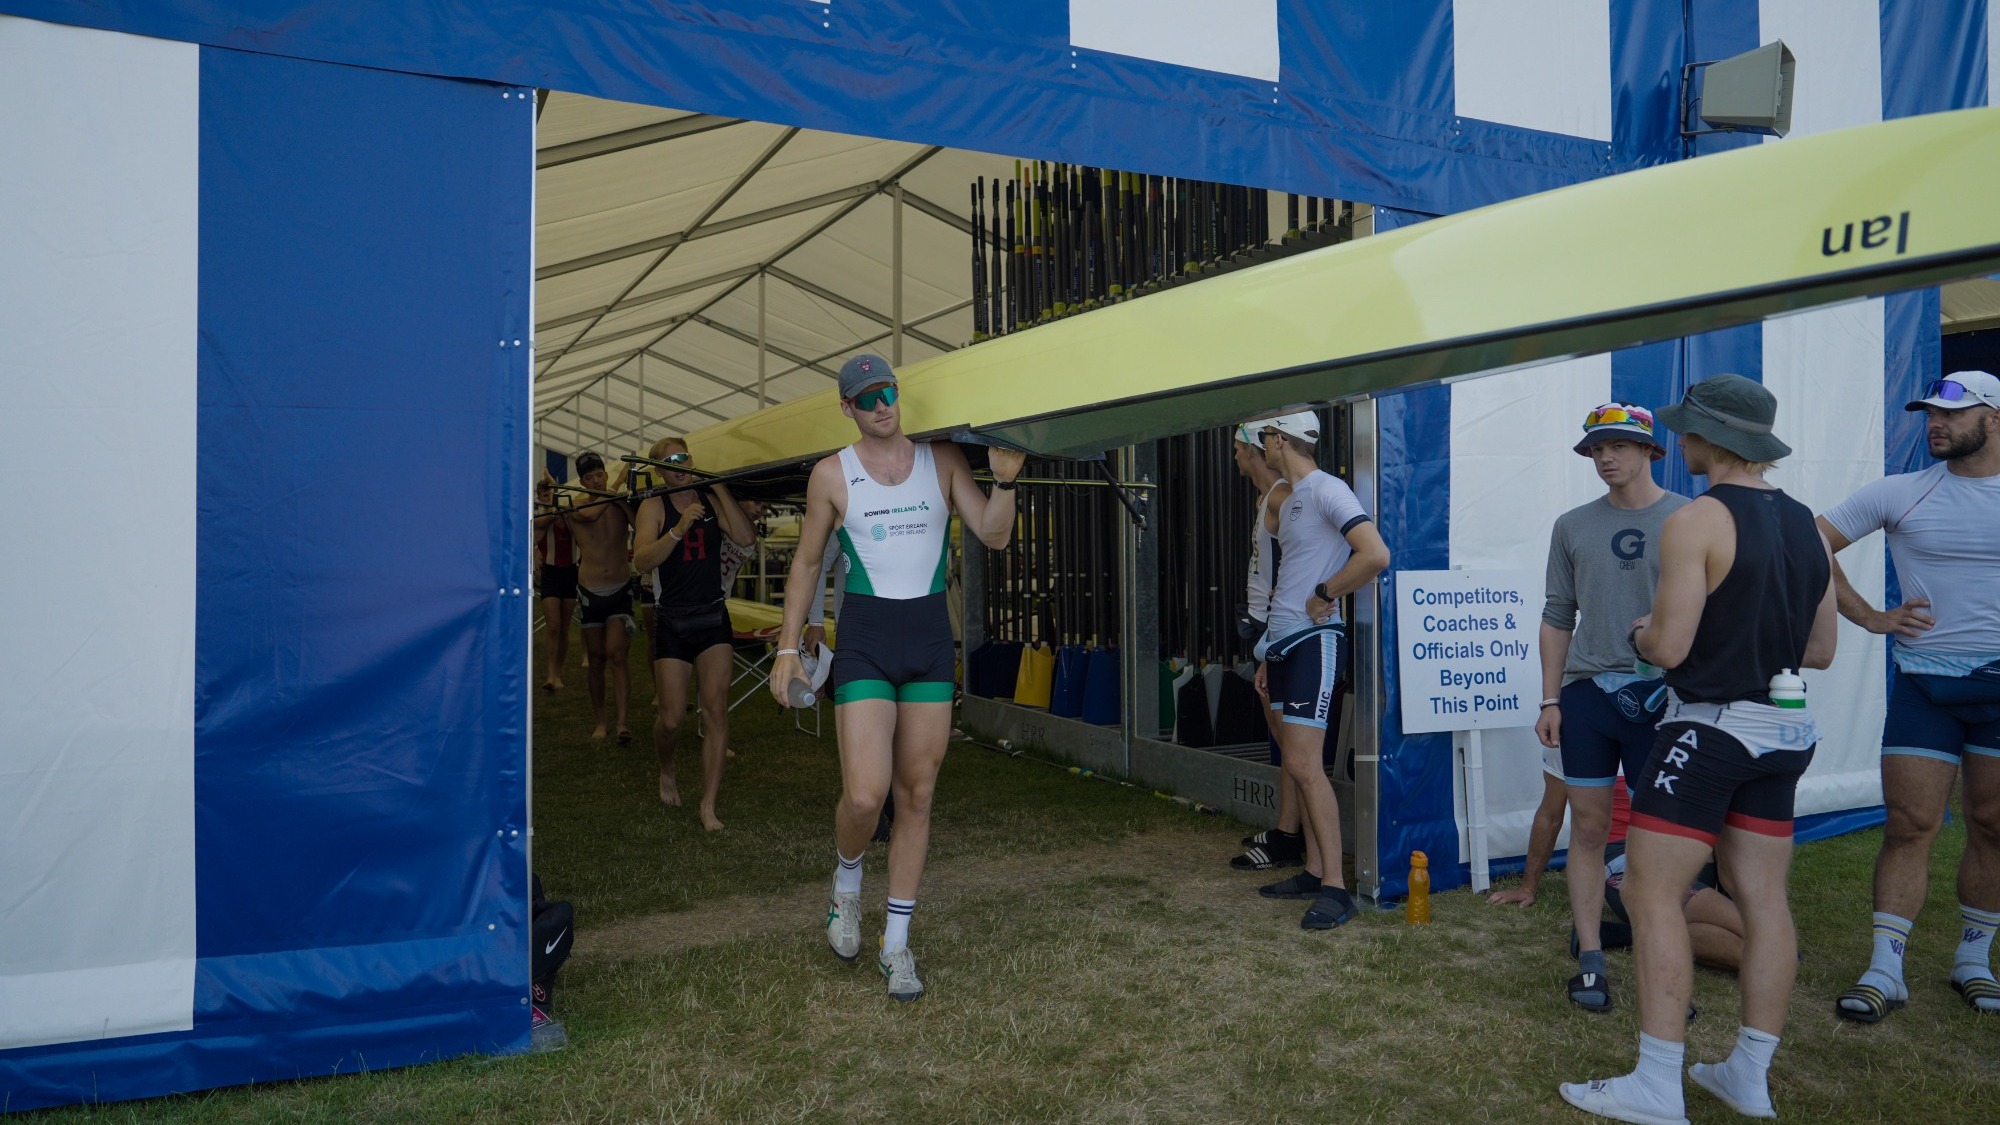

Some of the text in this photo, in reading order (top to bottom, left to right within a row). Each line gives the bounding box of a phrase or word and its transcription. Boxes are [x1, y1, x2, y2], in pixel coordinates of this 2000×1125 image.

[1822, 211, 1910, 257] Ian
[864, 505, 918, 518] ROWING IRELAND
[683, 528, 707, 562] H
[1611, 528, 1646, 560] G
[1413, 587, 1524, 609] Competitors,
[1423, 613, 1517, 632] Coaches &
[1413, 640, 1529, 660] Officials Only
[1440, 667, 1506, 690] Beyond
[1317, 691, 1331, 720] MUC
[1430, 694, 1519, 714] This Point
[1233, 777, 1276, 810] HRR
